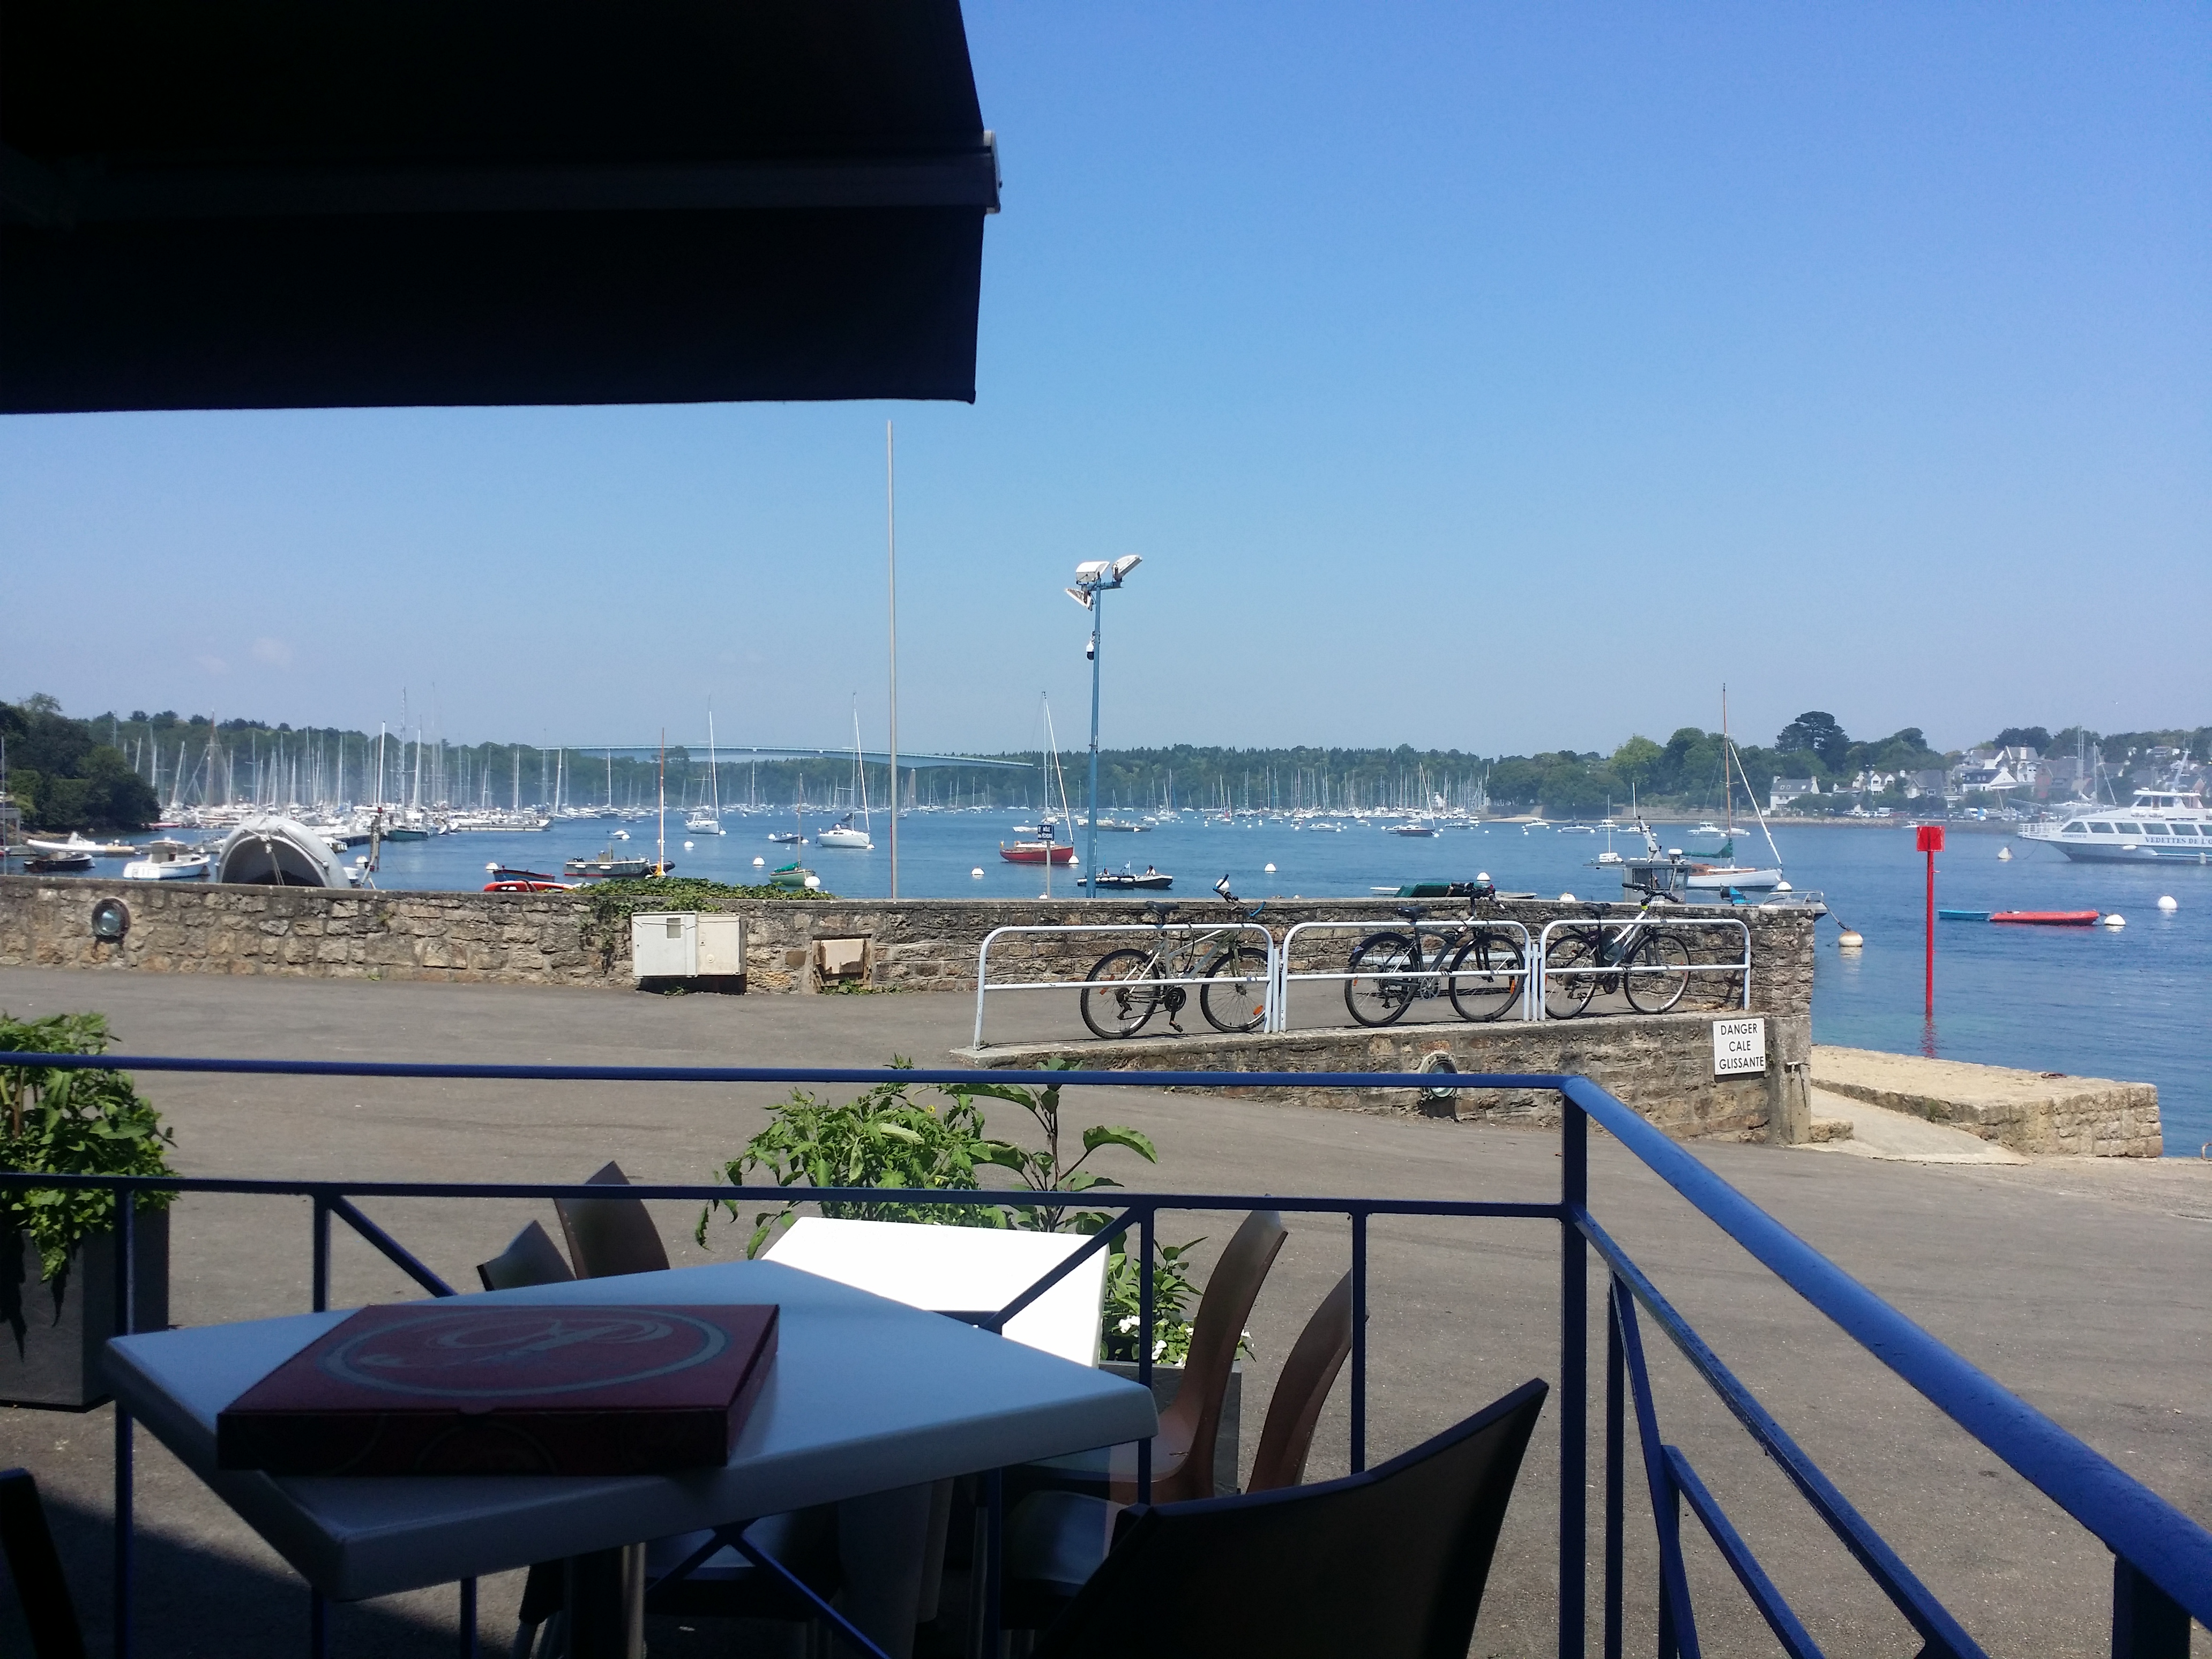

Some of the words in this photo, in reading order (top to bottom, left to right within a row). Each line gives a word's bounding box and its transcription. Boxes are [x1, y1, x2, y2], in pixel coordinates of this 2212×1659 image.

[1721, 1023, 1758, 1035] DANGER
[1729, 1040, 1751, 1052] CALE
[1719, 1056, 1764, 1070] GLISSANTE
